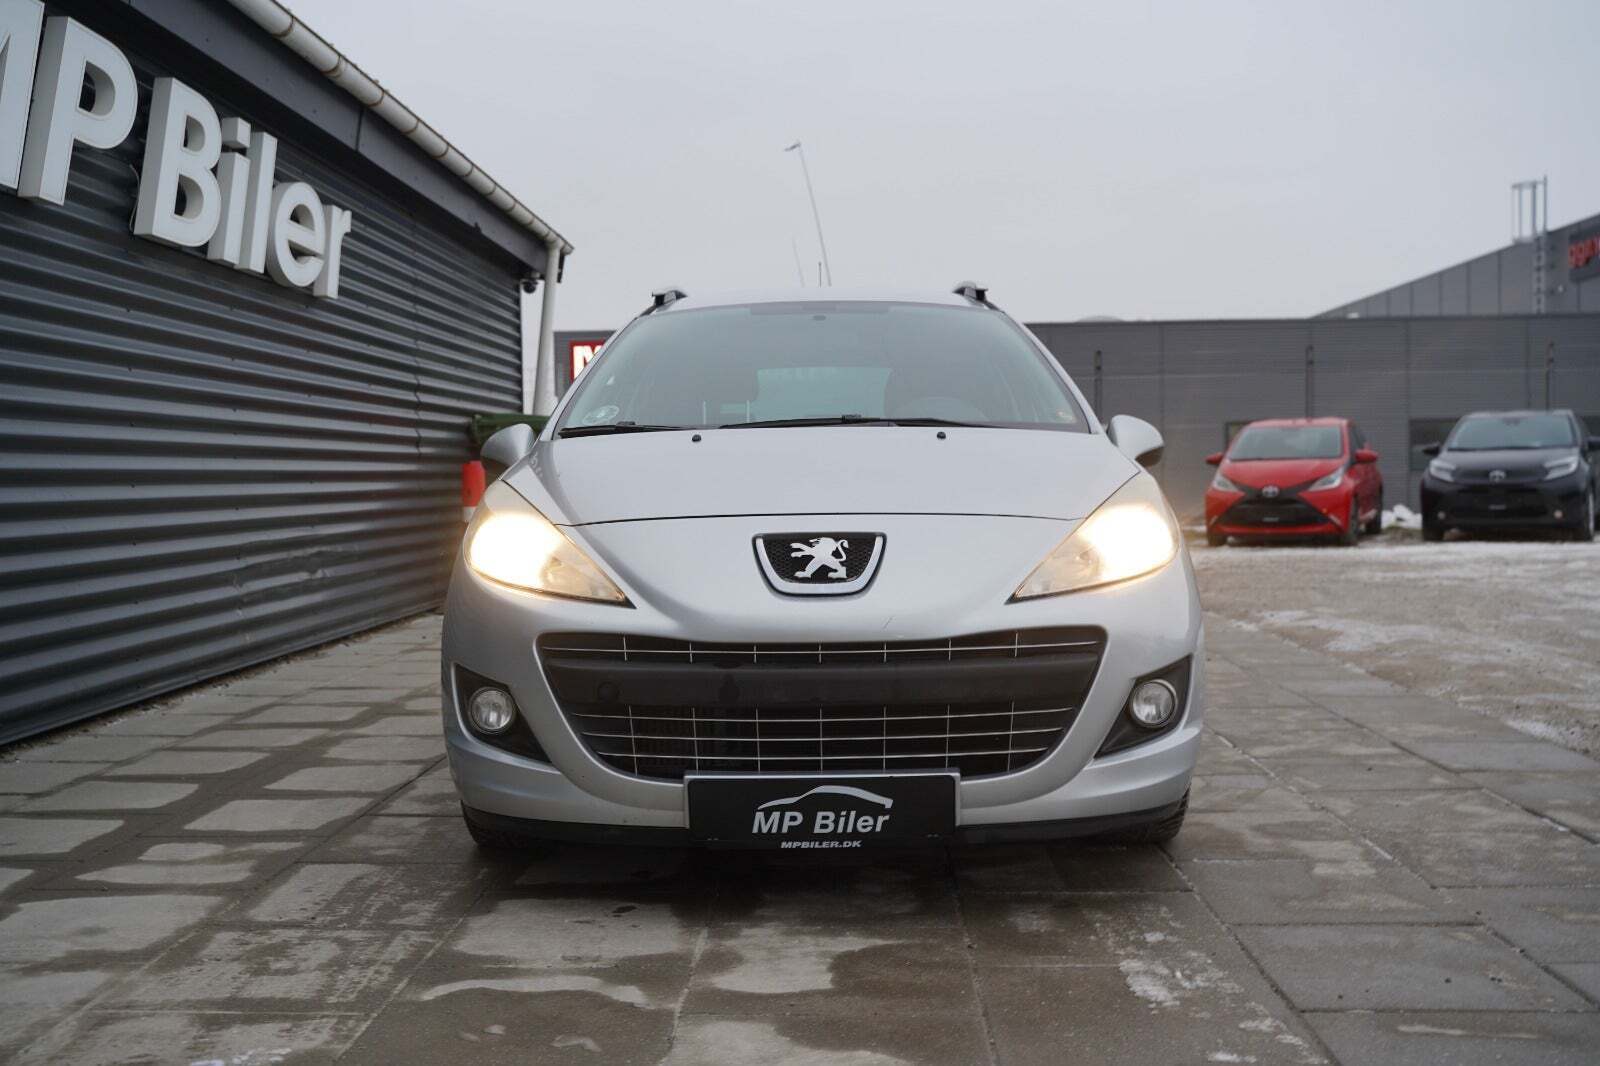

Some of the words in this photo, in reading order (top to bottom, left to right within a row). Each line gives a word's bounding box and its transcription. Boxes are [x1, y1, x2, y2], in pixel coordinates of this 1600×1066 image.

[134, 77, 352, 299] Biler
[752, 811, 803, 834] MP
[813, 810, 889, 834] Biler
[780, 840, 862, 848] MPBILER.DK
